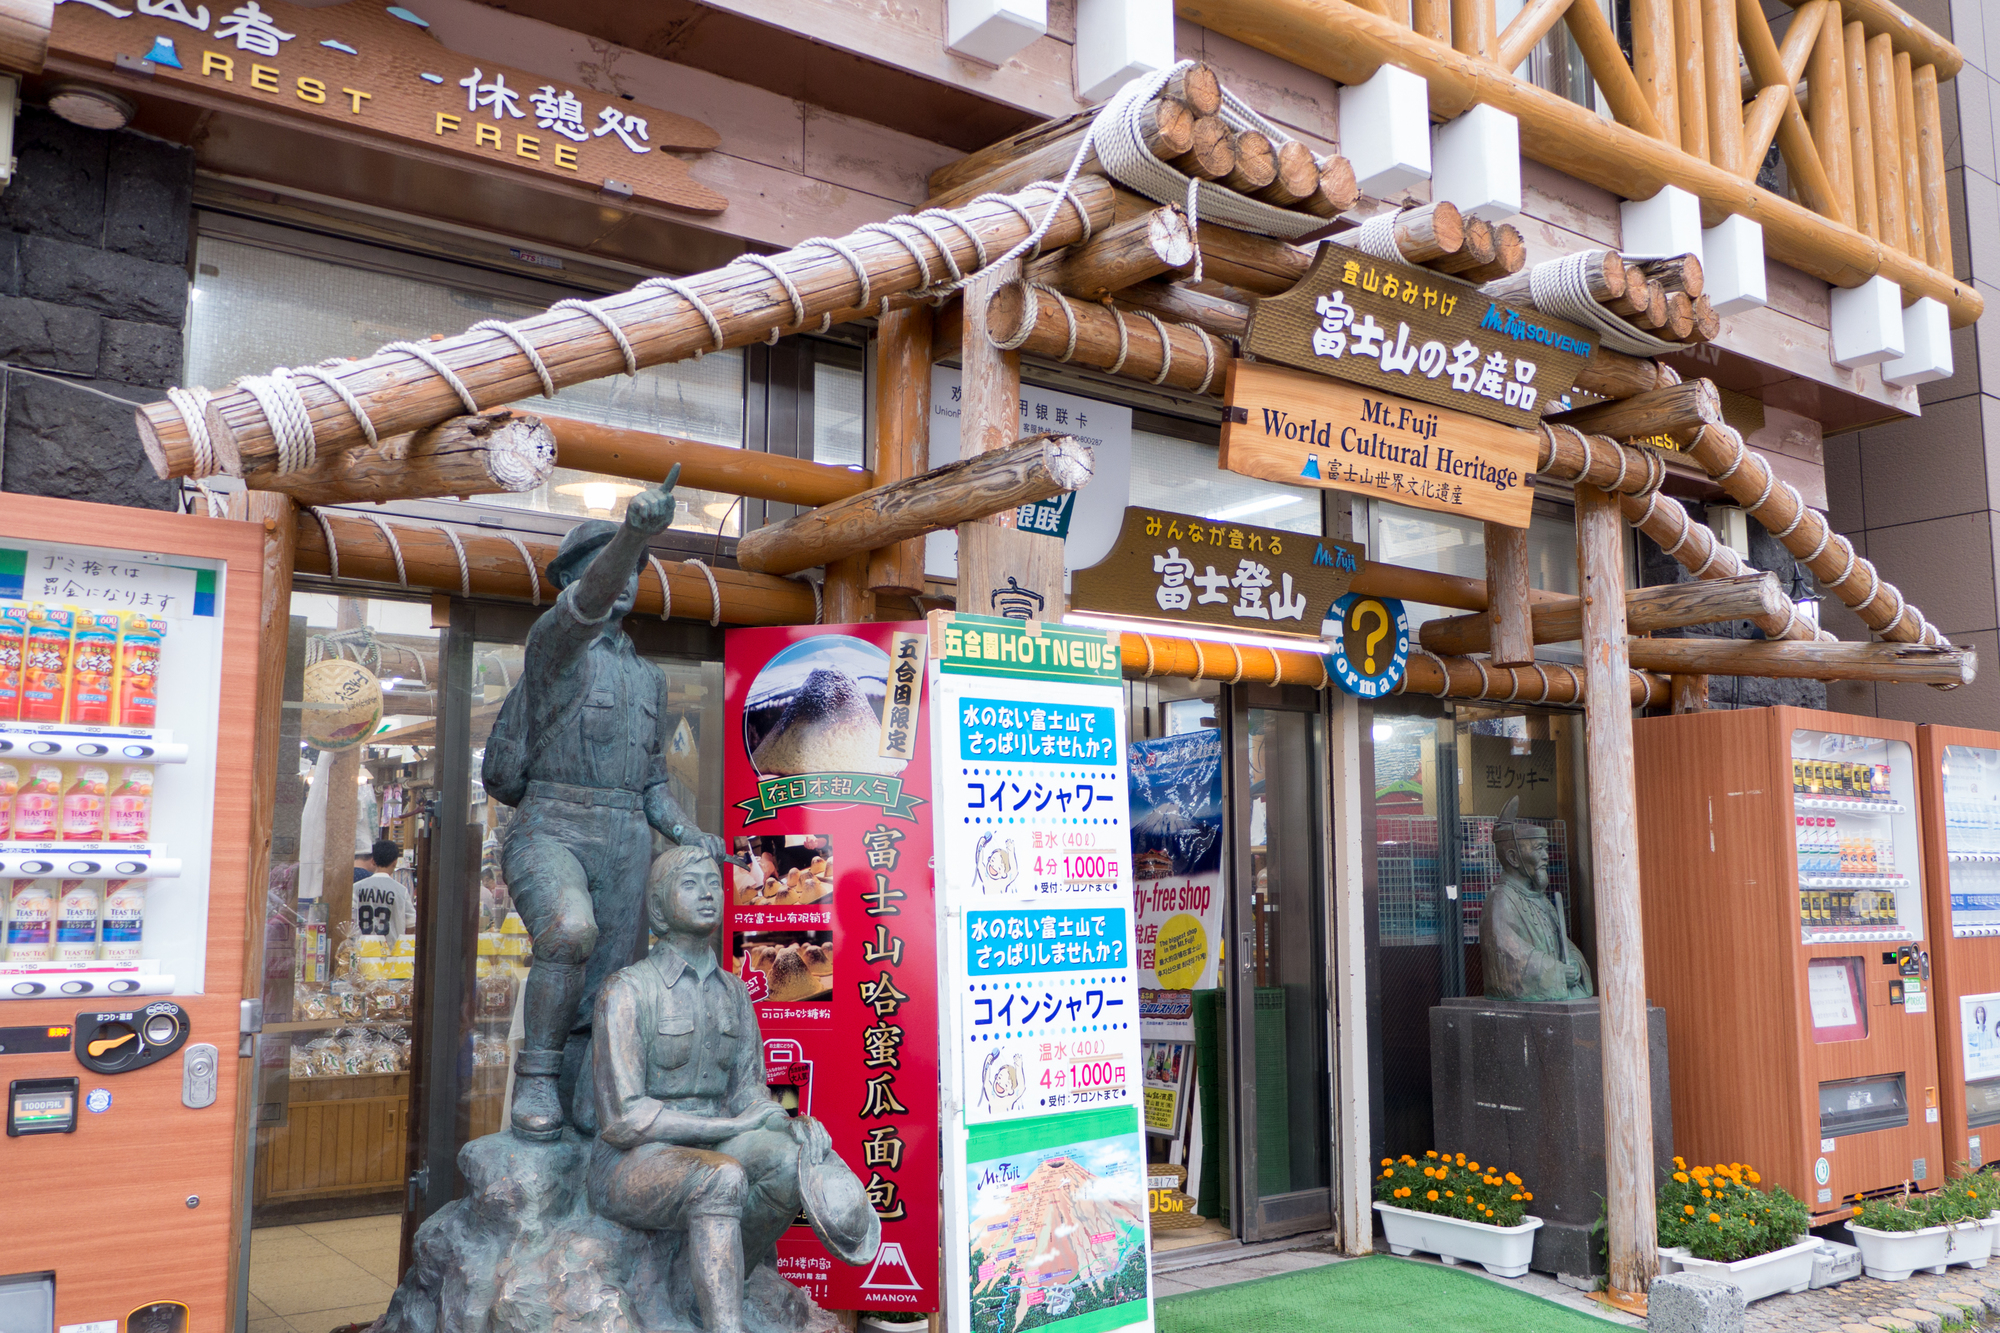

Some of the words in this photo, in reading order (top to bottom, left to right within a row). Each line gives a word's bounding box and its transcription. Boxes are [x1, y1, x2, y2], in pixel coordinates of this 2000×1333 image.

[201, 50, 373, 115] REST
[435, 112, 579, 171] FREE
[460, 68, 651, 154] 休憩処
[1341, 260, 1459, 317] 登山おみやげ
[1312, 290, 1538, 412] 富士山の名産品
[1525, 325, 1592, 359] SOUVENIR
[1261, 407, 1332, 449] World
[1340, 424, 1430, 469] Cultural
[1434, 445, 1519, 491] Heritage
[1325, 457, 1464, 506] 富士山世界文化遺産
[1145, 515, 1283, 556] みんなが登れる
[43, 555, 141, 579] ゴミ捨ては
[43, 577, 176, 613] 罰金になります
[1152, 546, 1307, 621] 富士登山
[963, 704, 1096, 733] 水のない富士山で
[967, 731, 1113, 759] さっぱりしませんか?
[767, 776, 891, 803] 在日本超人气
[967, 781, 1114, 813] コインシャワー
[1063, 855, 1119, 880] 1,000円
[358, 888, 395, 906] WANG
[1178, 880, 1211, 917] shop
[358, 905, 392, 936] 83
[971, 914, 1106, 943] 水のない富士山で
[976, 939, 1123, 969] さっぱりしませんか?
[761, 1008, 831, 1020] 可可和砂糖粉
[974, 989, 1124, 1027] コインシャワー
[1070, 1062, 1126, 1088] 1,000円
[24, 1101, 62, 1110] 1000円札
[998, 1163, 1021, 1182] Fuji
[864, 1293, 918, 1303] AMANOYA
